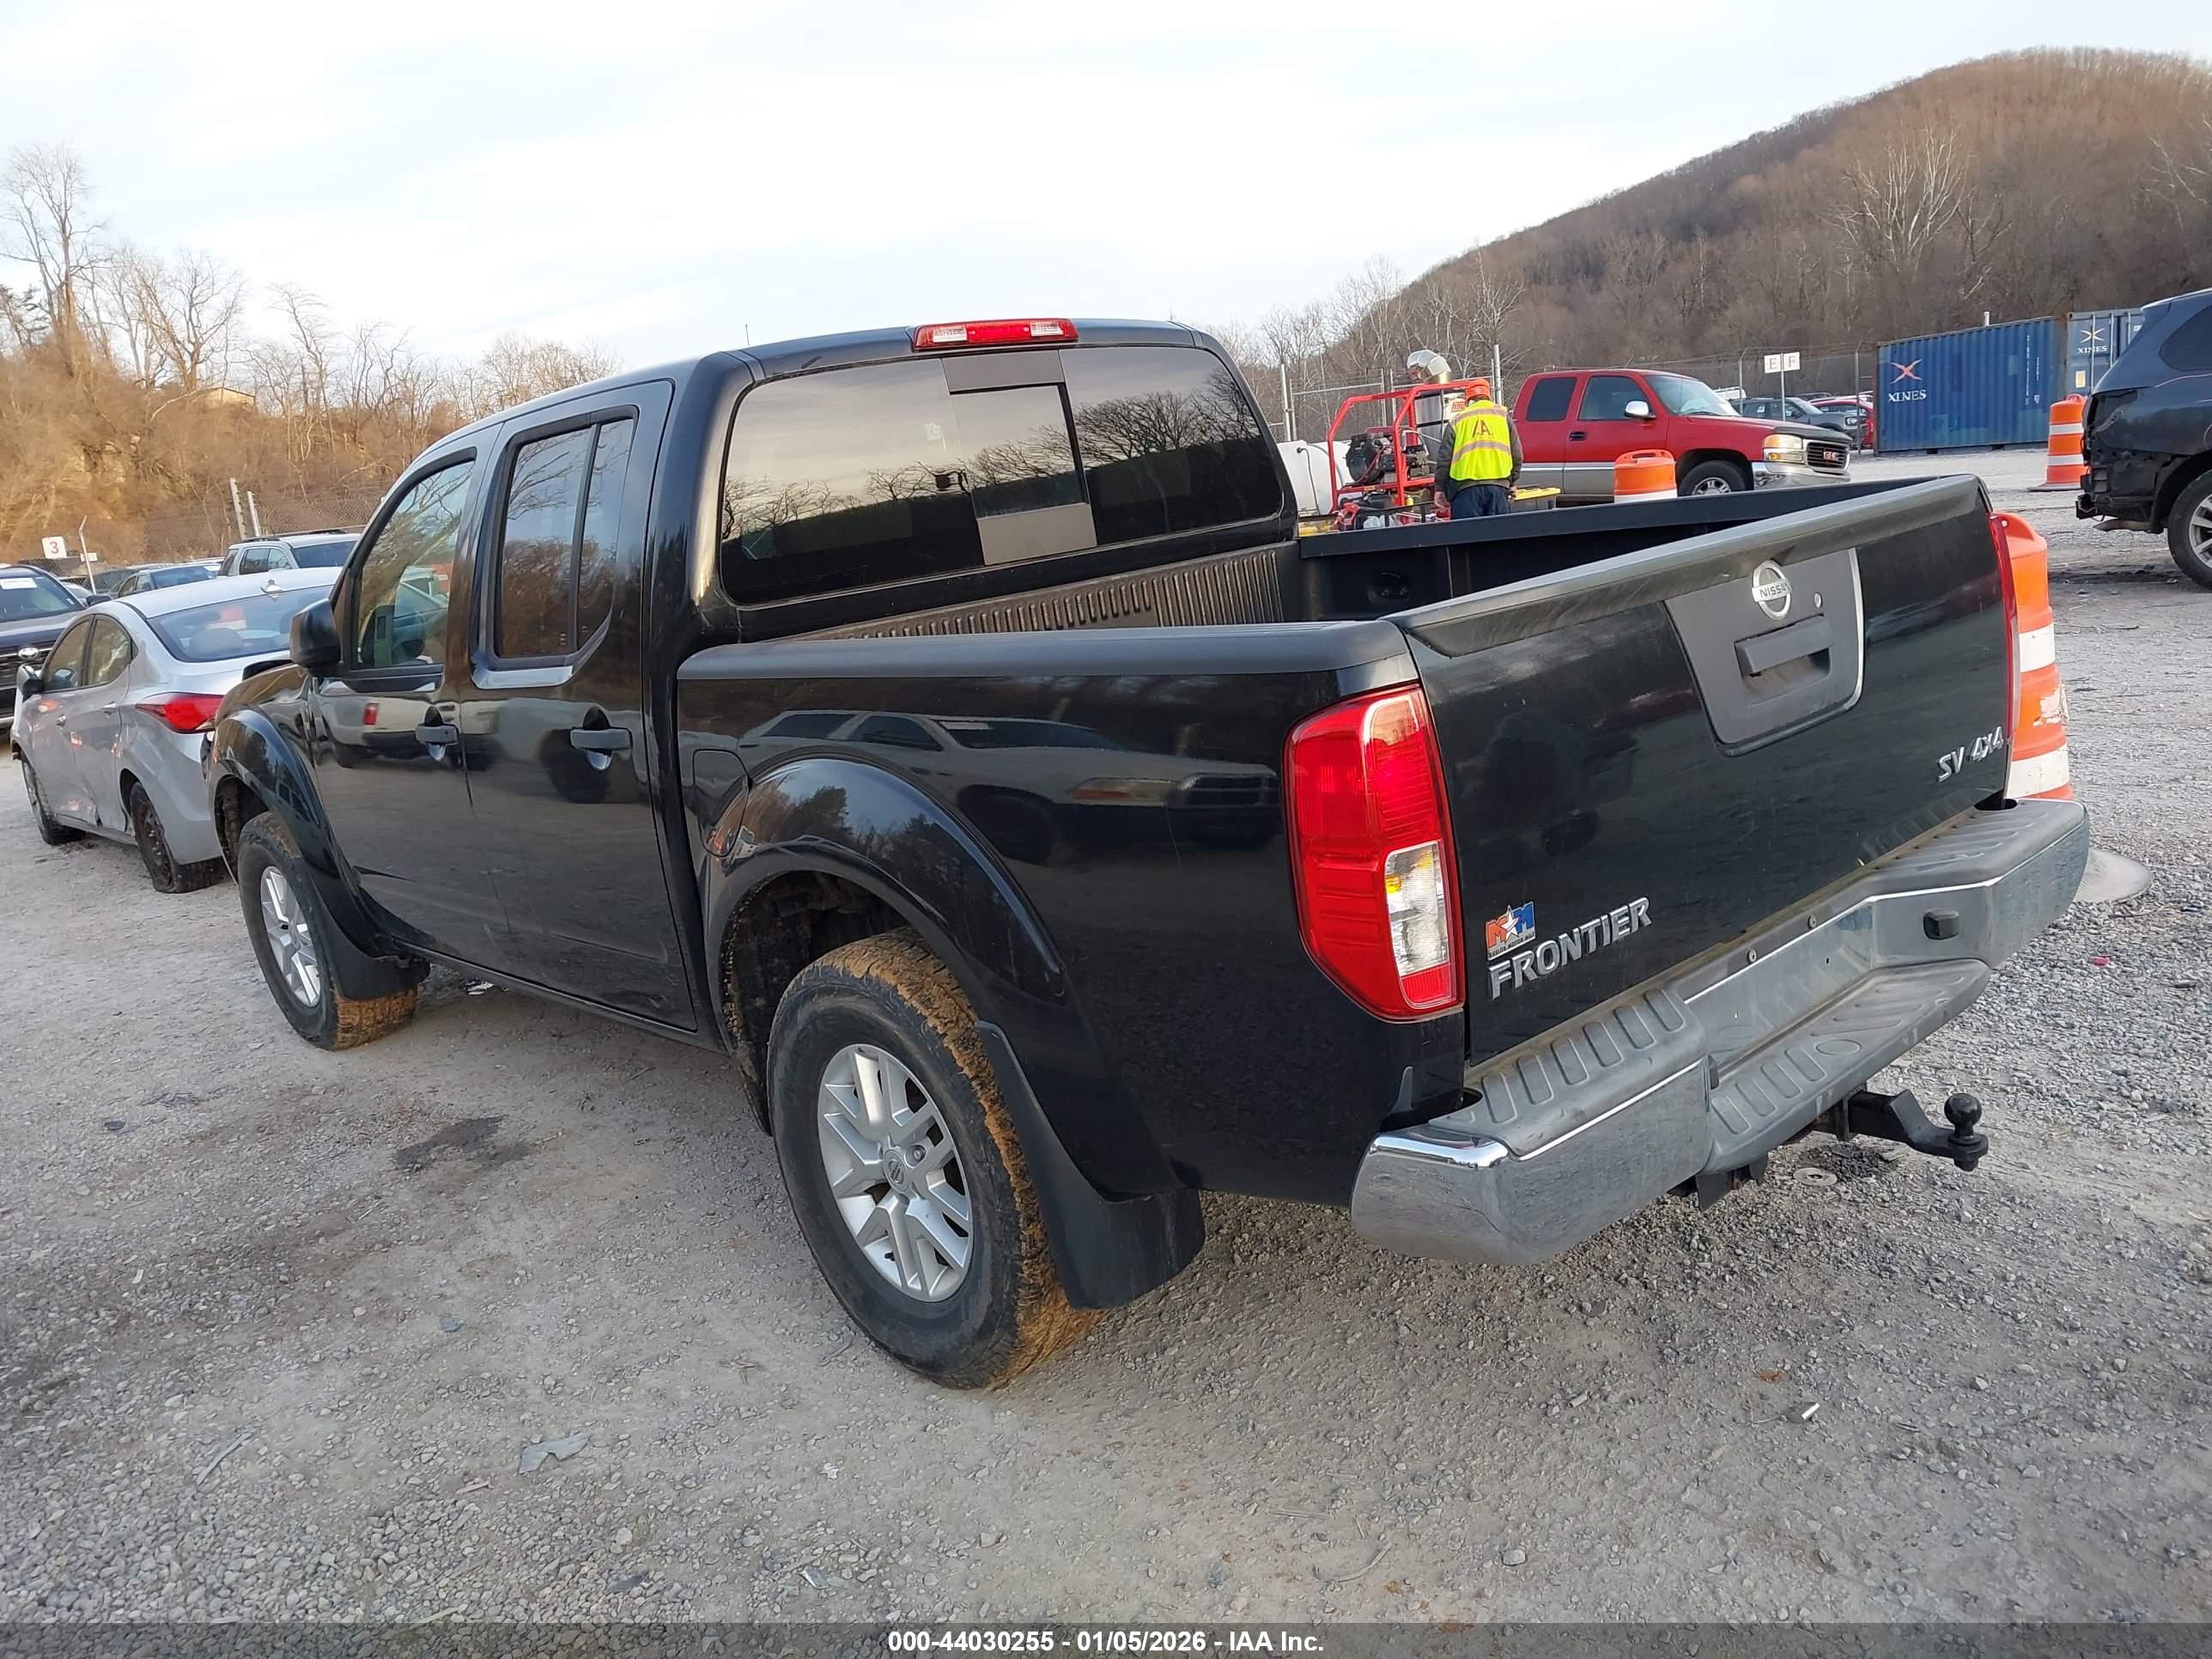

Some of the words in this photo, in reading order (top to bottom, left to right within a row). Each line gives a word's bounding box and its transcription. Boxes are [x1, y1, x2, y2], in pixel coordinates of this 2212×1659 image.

[1769, 358, 1778, 369] E
[1788, 356, 1796, 368] F
[1888, 389, 1928, 403] XINES
[49, 541, 59, 554] 3
[1938, 746, 1966, 782] SV
[1488, 896, 1652, 1000] FRONTIER
